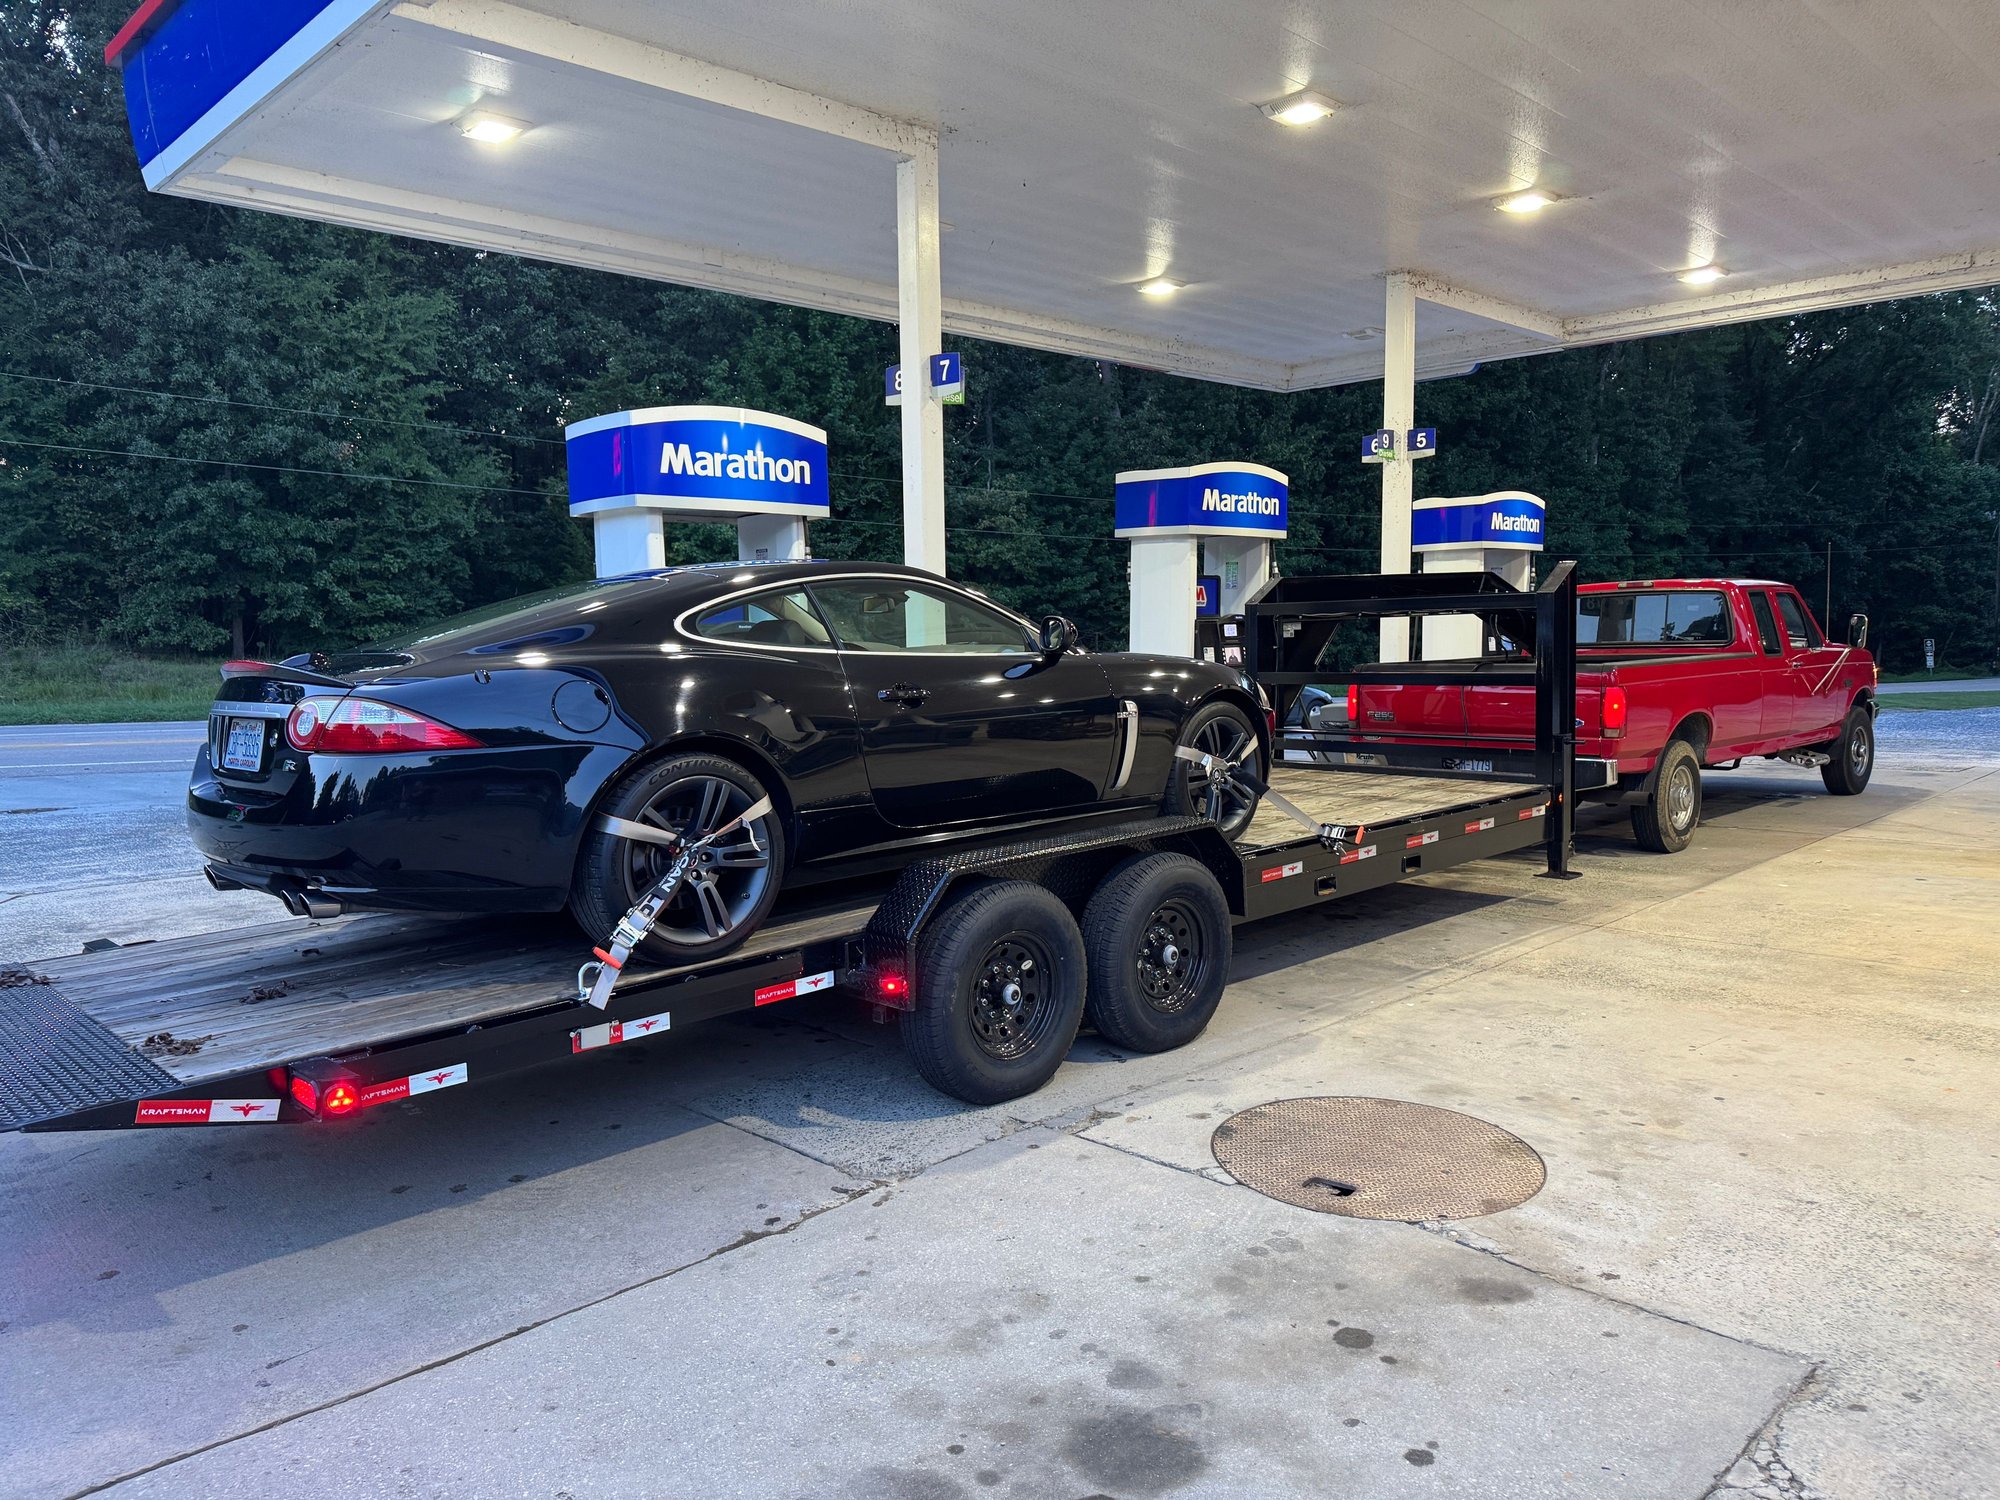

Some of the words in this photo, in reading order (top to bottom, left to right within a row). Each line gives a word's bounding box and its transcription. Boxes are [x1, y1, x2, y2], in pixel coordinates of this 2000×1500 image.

[940, 359, 950, 382] 7
[1382, 433, 1389, 449] 9
[1416, 432, 1427, 448] 5
[660, 442, 811, 485] Marathon
[1202, 488, 1280, 516] Marathon
[1491, 512, 1540, 533] Marathon
[228, 757, 239, 766] NORTH
[240, 759, 256, 768] CAROLINA
[757, 987, 794, 1001] KRAFTSMAN
[141, 1108, 207, 1116] KRAFTSMAN
